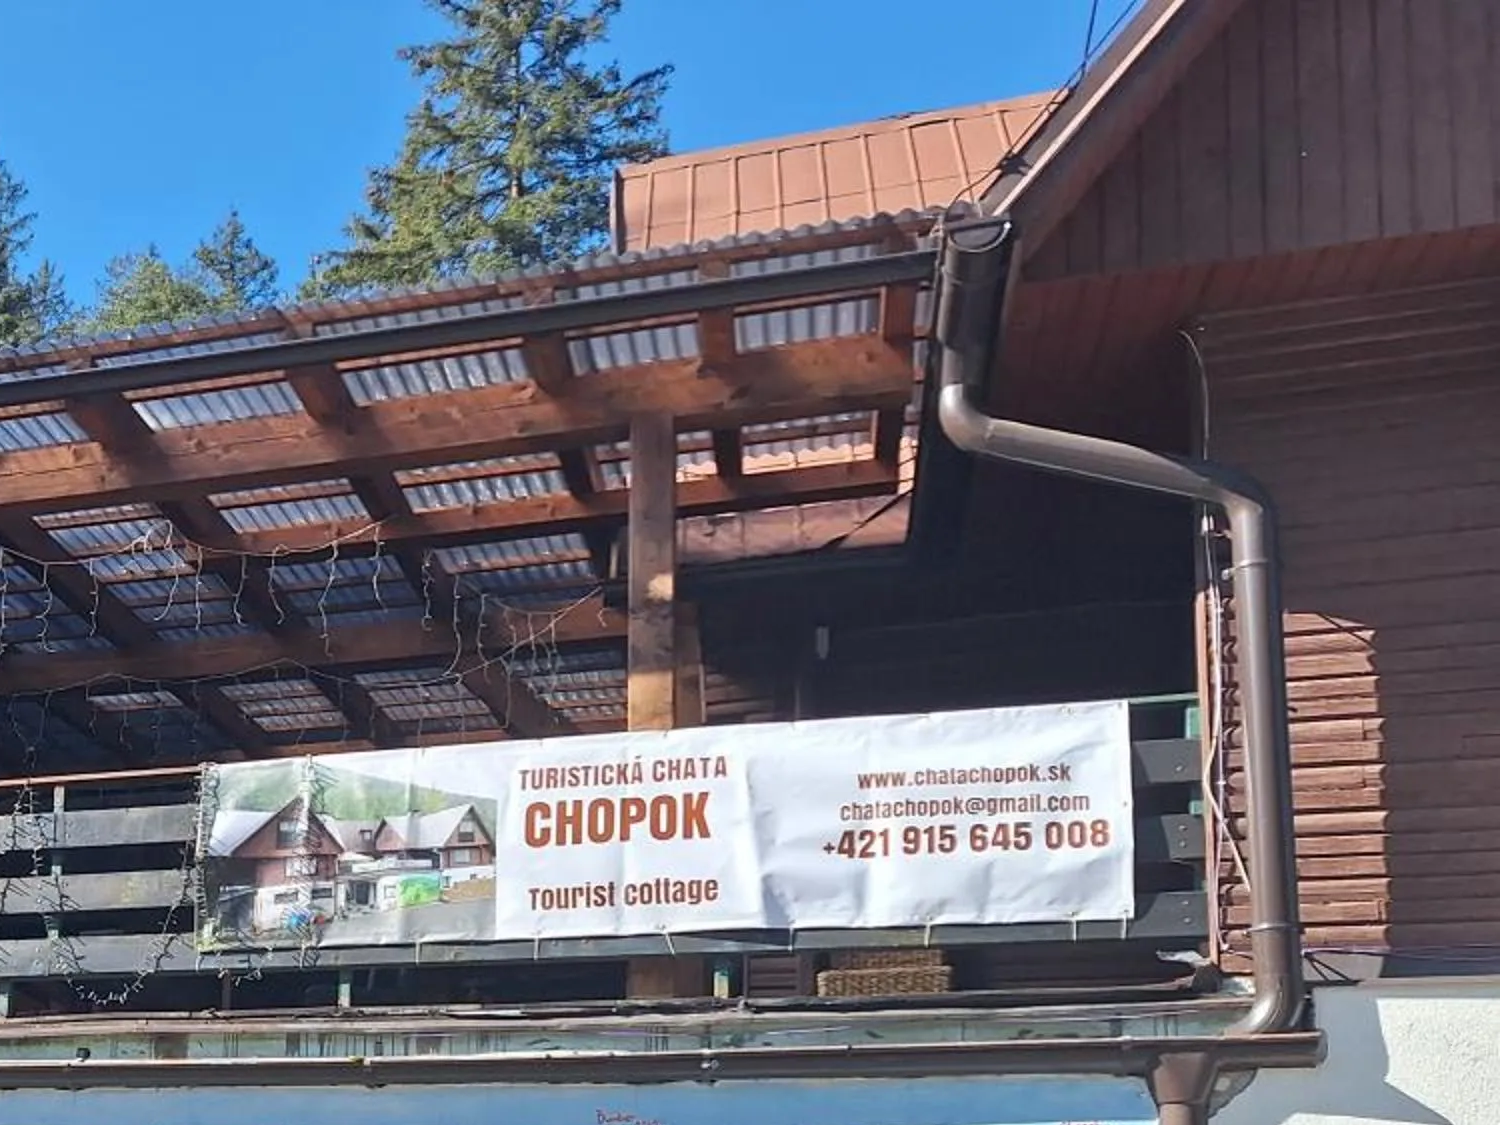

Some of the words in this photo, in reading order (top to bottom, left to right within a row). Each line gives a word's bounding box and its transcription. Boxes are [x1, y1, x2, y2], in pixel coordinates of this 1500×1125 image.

[520, 756, 643, 790] TURISTICKÁ
[653, 756, 728, 783] CHATA
[857, 762, 1072, 789] www.chatachopok.sk
[525, 791, 711, 848] CHOPOK
[840, 793, 1090, 821] chatachopok@gmail.com
[823, 828, 890, 859] +421
[902, 825, 957, 854] 915
[969, 822, 1033, 852] 645
[1045, 819, 1111, 850] 008
[529, 881, 615, 911] Tourist
[624, 878, 719, 906] cottage
